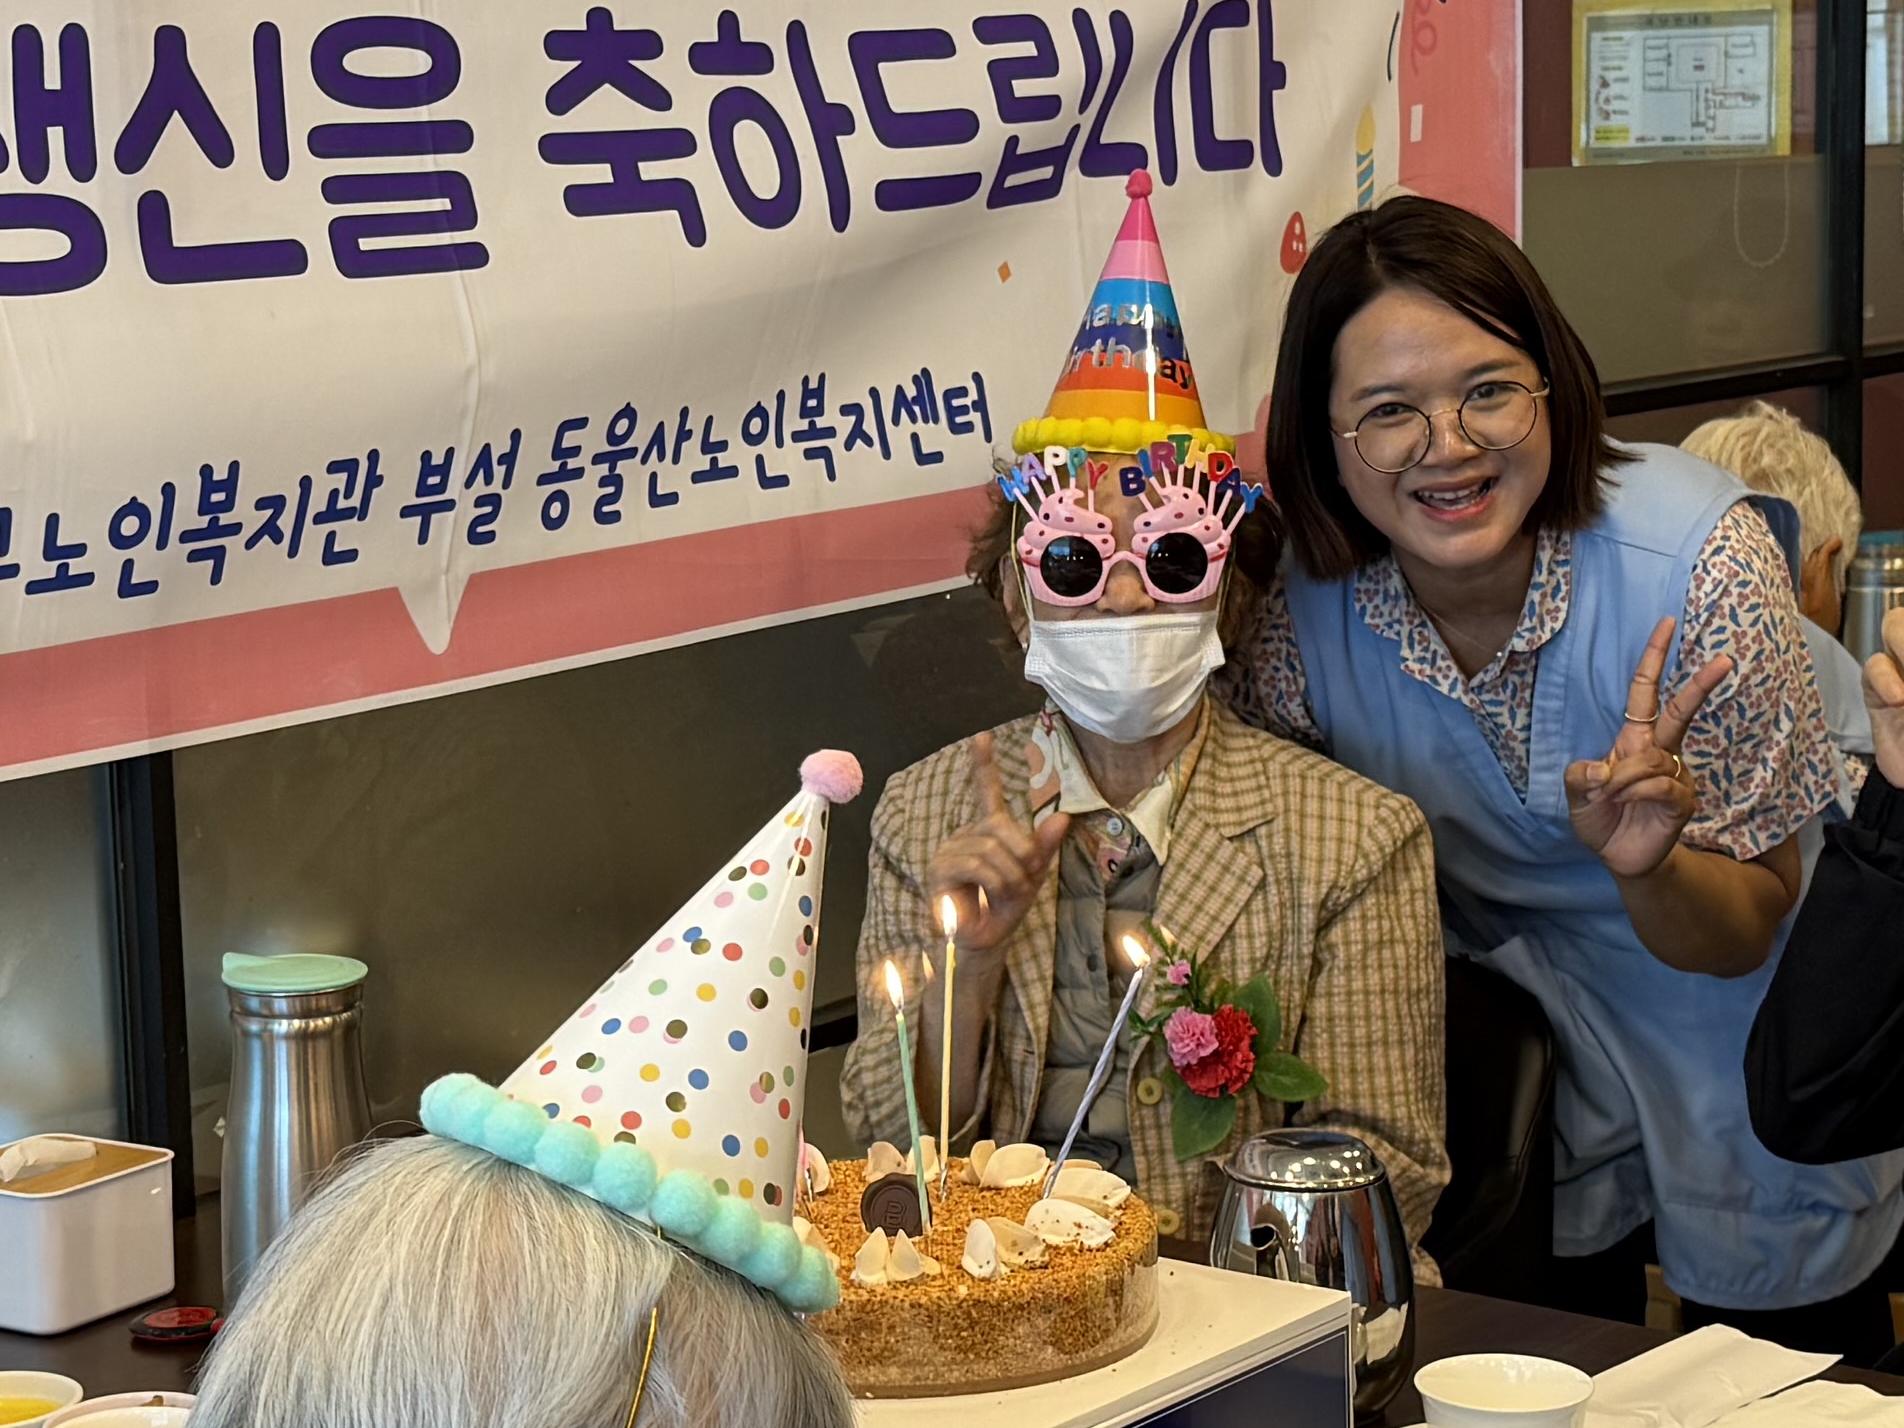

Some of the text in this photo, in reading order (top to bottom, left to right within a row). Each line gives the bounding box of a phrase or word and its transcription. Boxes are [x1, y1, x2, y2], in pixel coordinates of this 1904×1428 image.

[400, 428, 523, 547] 부설
[537, 369, 994, 529] 동울산노인복지센터
[997, 433, 1264, 513] HAPPY BIRTHDAY
